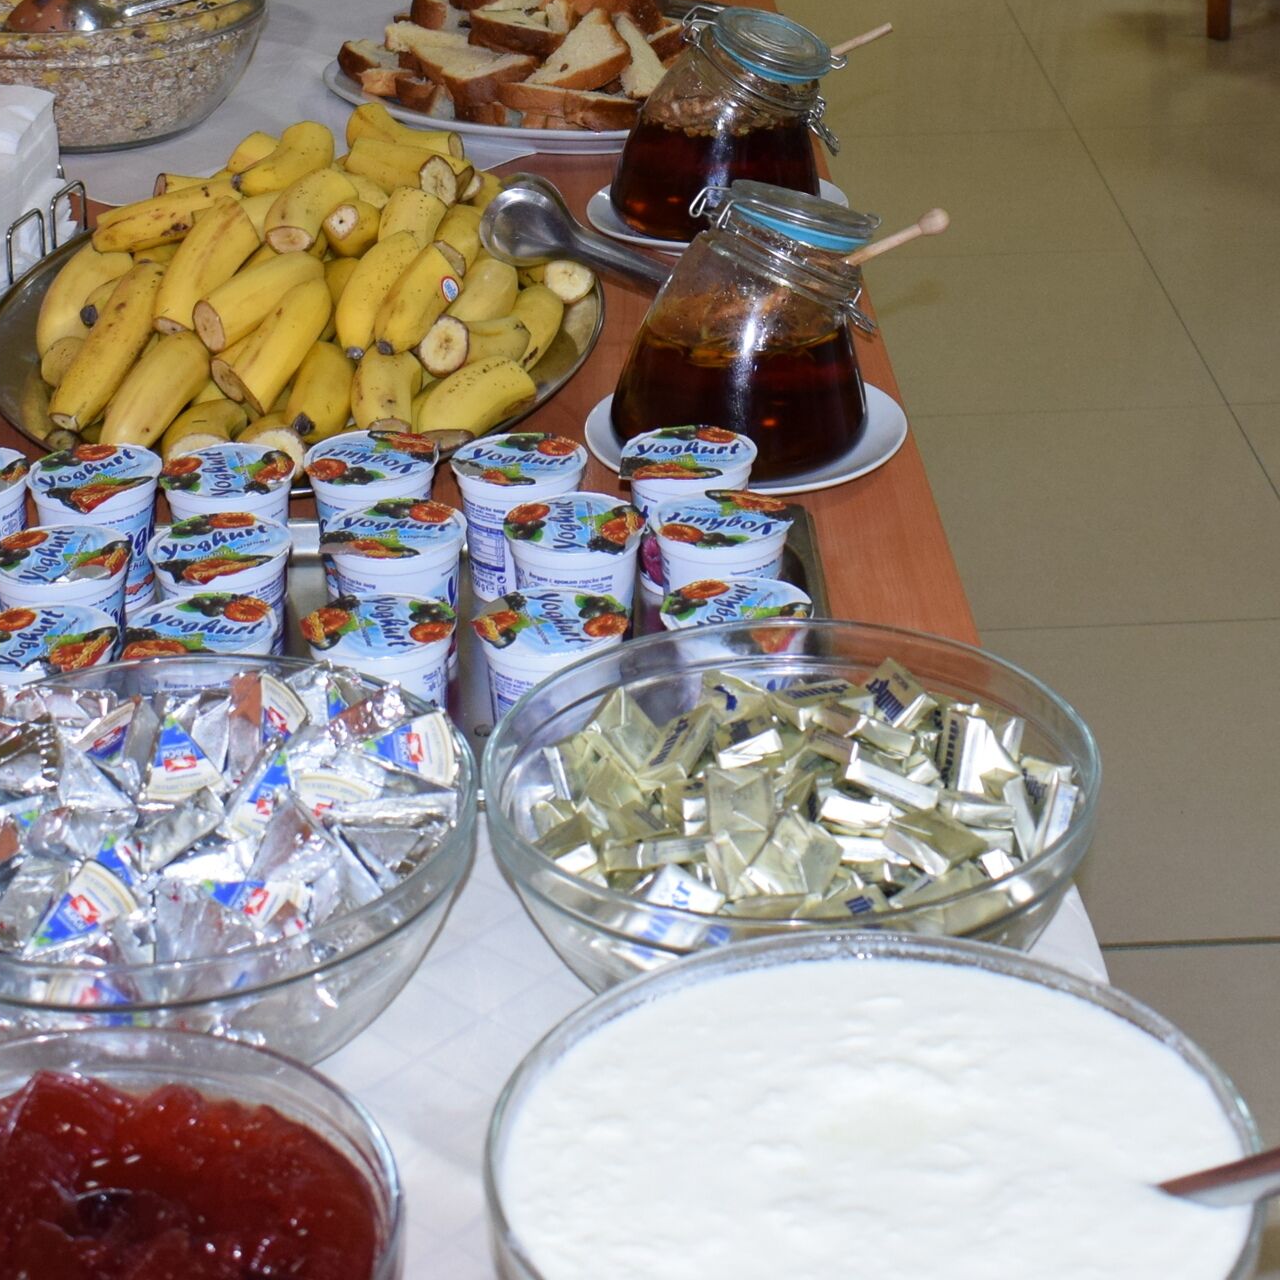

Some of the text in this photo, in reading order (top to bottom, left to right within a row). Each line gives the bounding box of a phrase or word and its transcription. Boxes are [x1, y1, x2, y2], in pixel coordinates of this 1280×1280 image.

[317, 448, 422, 474] Yoghurt
[467, 448, 575, 466] Yoghurt
[635, 441, 741, 456] Yoghurt
[37, 448, 136, 488] Yoghurt
[198, 451, 243, 497] Yoghurt
[338, 517, 451, 532] Yoghurt
[547, 500, 586, 550] Yoghurt
[665, 511, 778, 536] Yoghurt
[18, 529, 76, 583] Yoghurt
[160, 524, 269, 560] Yoghurt
[142, 612, 265, 636] Yoghurt
[362, 597, 416, 647] Yoghurt
[526, 592, 593, 643] Yoghurt
